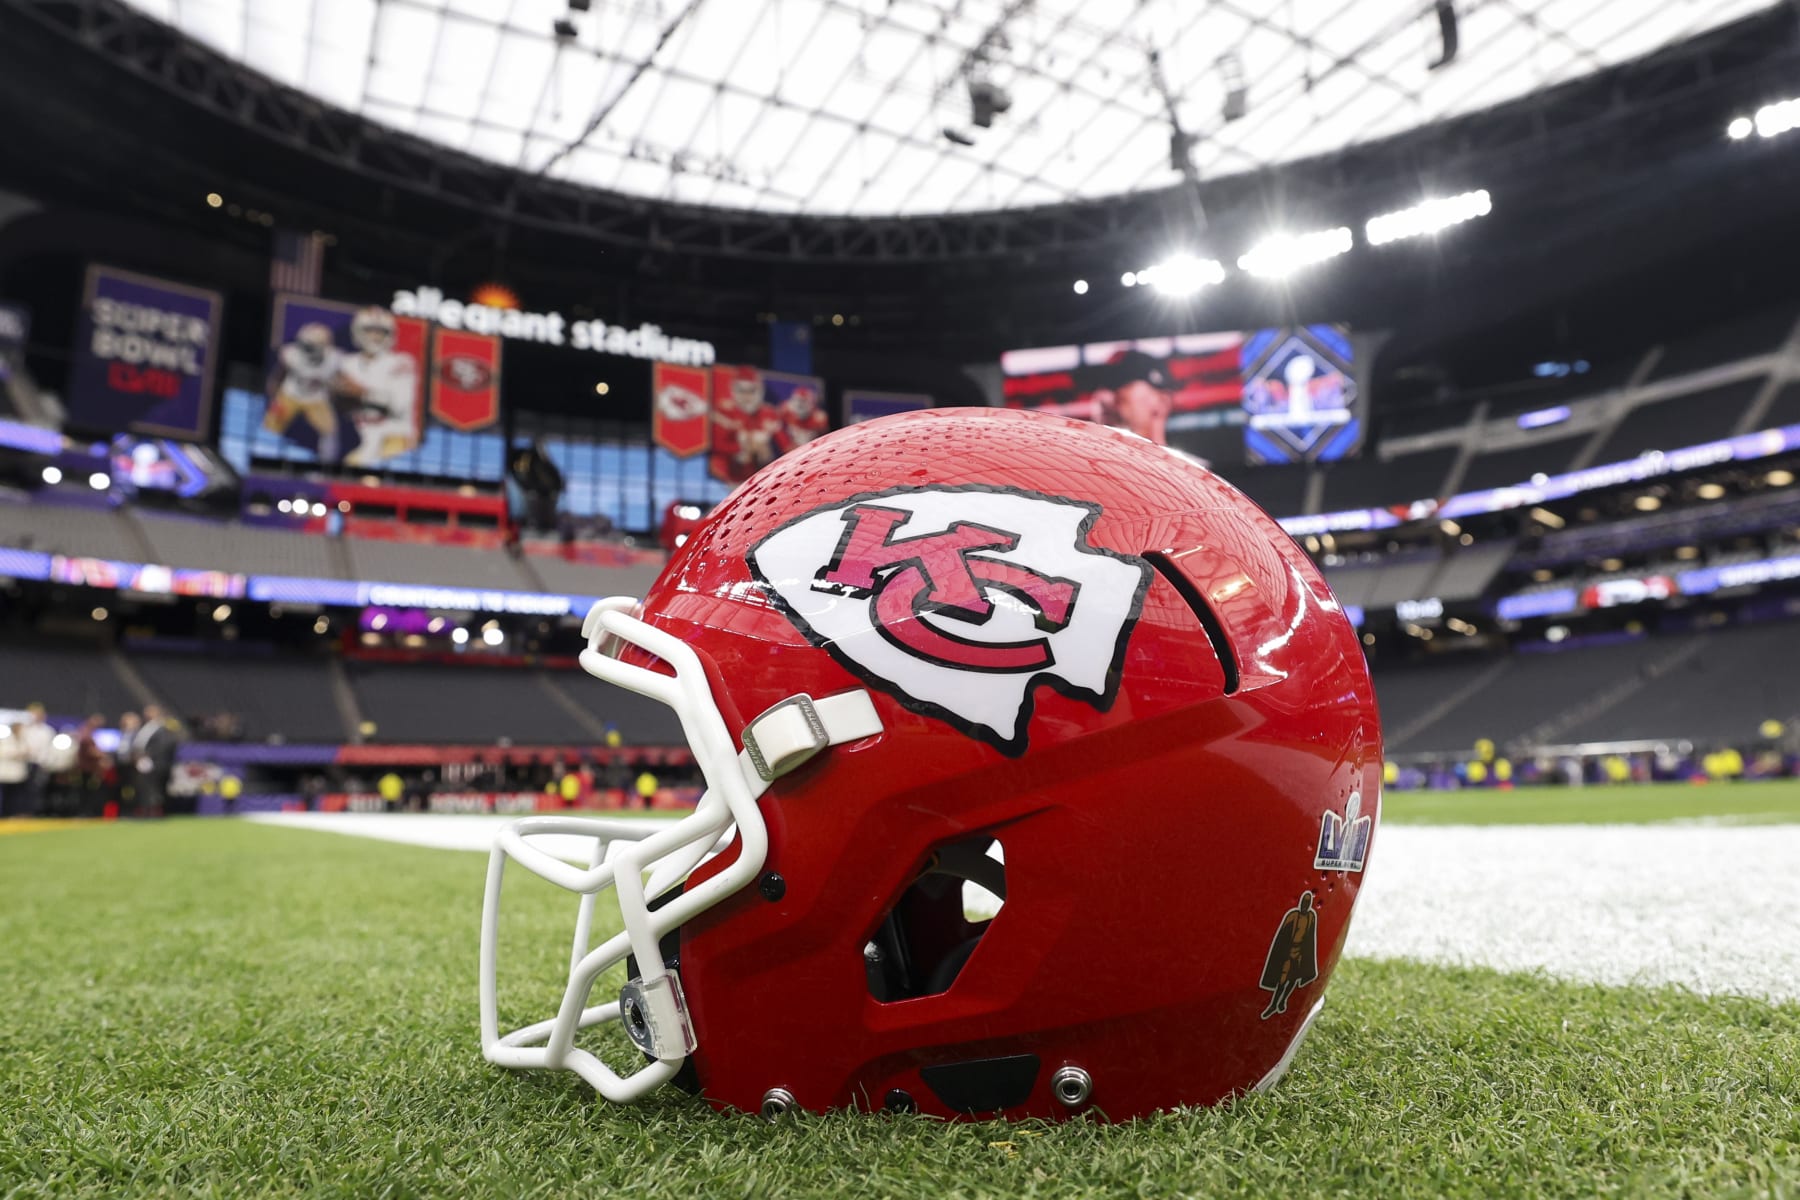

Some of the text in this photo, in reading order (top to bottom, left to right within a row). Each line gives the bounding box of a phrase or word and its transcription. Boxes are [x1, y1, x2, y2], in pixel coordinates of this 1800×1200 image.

[92, 298, 208, 342] SUPER
[92, 328, 200, 376] BOWL
[391, 285, 716, 365] allegiant stadium
[811, 504, 1081, 674] KC
